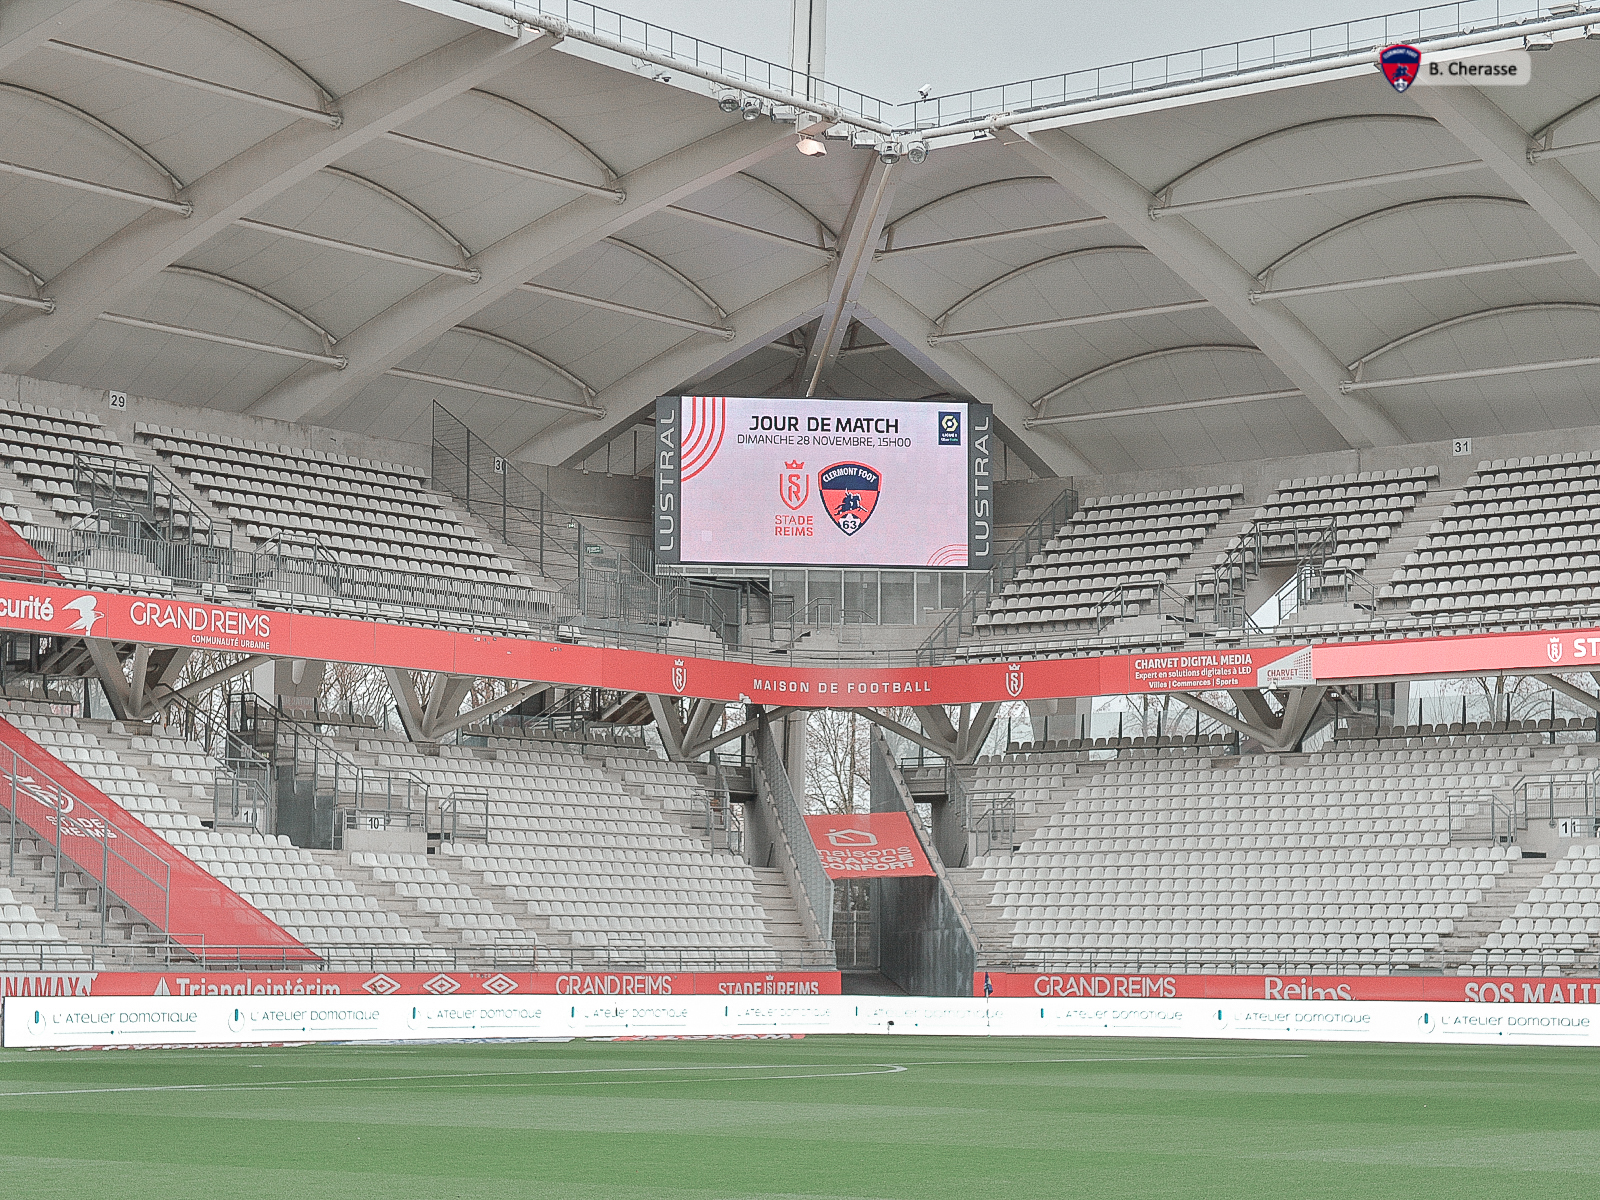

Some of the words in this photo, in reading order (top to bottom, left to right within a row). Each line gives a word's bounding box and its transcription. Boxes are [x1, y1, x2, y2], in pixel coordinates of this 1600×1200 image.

[111, 394, 125, 408] 29
[749, 416, 799, 432] JOUR
[807, 416, 831, 432] DE
[836, 418, 899, 434] MATCH
[737, 434, 794, 446] DIMANCHE
[796, 434, 810, 446] 28
[812, 435, 876, 448] NOVEMBRE,
[878, 437, 912, 448] 15H00
[1454, 441, 1468, 453] 31
[660, 409, 676, 552] LUSTRAL
[822, 466, 858, 482] CLERMONT
[858, 469, 878, 483] FOOT
[976, 416, 990, 557] LUSTRAL
[774, 514, 814, 526] STADE
[842, 520, 857, 530] 63
[774, 526, 814, 537] REIMS
[130, 602, 208, 632] GRAND
[211, 611, 270, 638] REIMS
[191, 634, 238, 648] COMMUNAUTÉ
[240, 639, 270, 650] URBAINE
[1573, 637, 1600, 658] ST
[1134, 658, 1179, 670] CHARVET
[1180, 656, 1218, 668] DIGITAL
[1220, 654, 1252, 666] MEDIA
[1135, 671, 1158, 680] Expert
[1168, 668, 1200, 678] solutions
[1201, 667, 1231, 677] digitales
[1232, 666, 1237, 675] à
[1238, 666, 1252, 674] LED
[1267, 668, 1298, 677] CHARVET
[753, 678, 810, 693] MAISON
[818, 681, 839, 693] DE
[848, 680, 932, 693] FOOTBALL
[1148, 680, 1167, 689] Villes
[1172, 679, 1211, 688] Commerces
[1215, 678, 1239, 686] Sports
[368, 816, 380, 830] 10
[556, 976, 621, 995] GRAND
[623, 976, 672, 995] REIMS
[1034, 976, 1111, 998] GRAND
[1114, 976, 1176, 998] REIMS
[1264, 977, 1352, 1000] Reims
